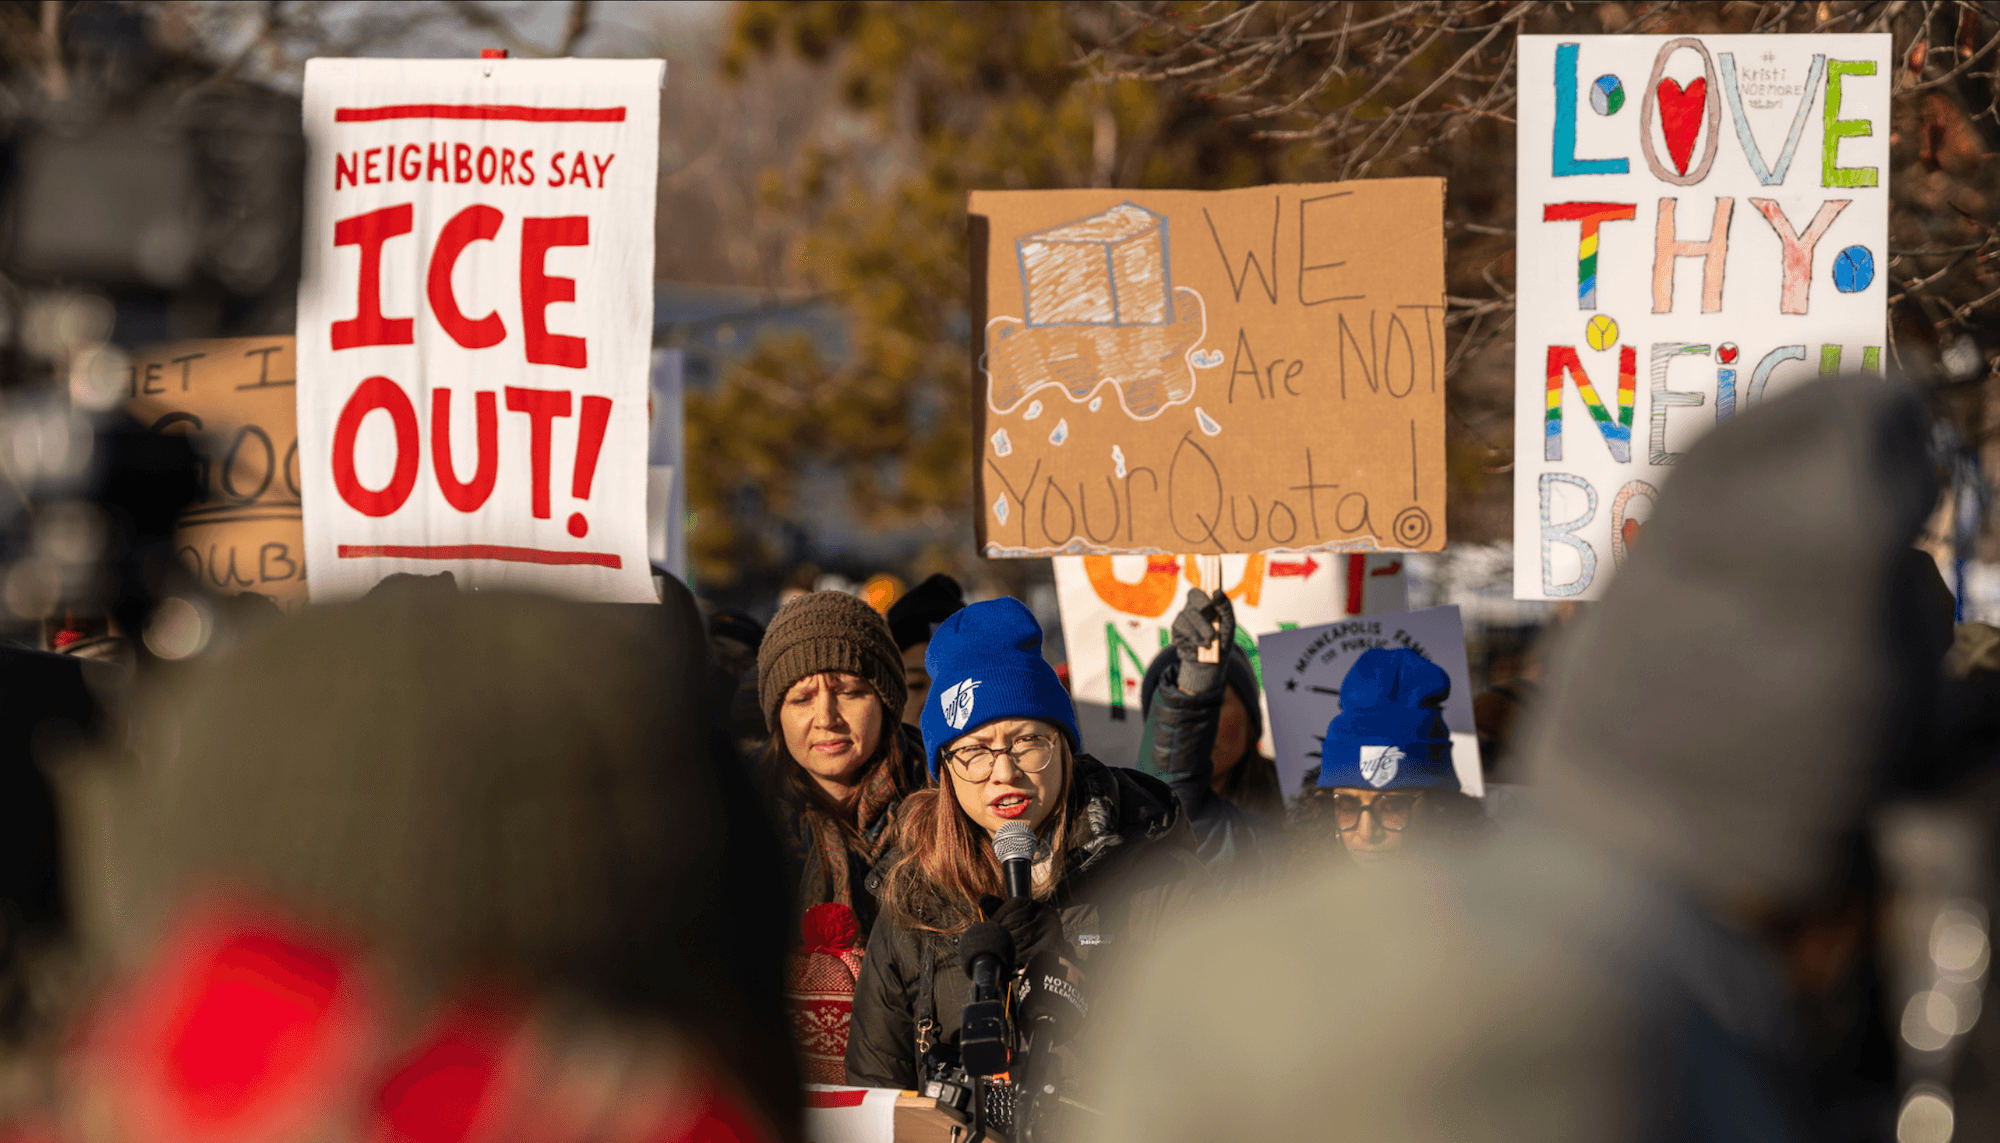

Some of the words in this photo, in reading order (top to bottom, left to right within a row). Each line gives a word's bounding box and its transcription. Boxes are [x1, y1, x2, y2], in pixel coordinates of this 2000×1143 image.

[335, 142, 535, 190] NEIGHBORS
[547, 151, 616, 189] SAY
[1552, 37, 1879, 187] LOVE
[331, 201, 590, 369] ICE
[1203, 191, 1366, 306] WE
[1543, 197, 1853, 316] THY
[1229, 327, 1304, 403] Are
[1338, 305, 1447, 401] NOT
[331, 375, 613, 538] OUT!
[987, 457, 1158, 549] Your
